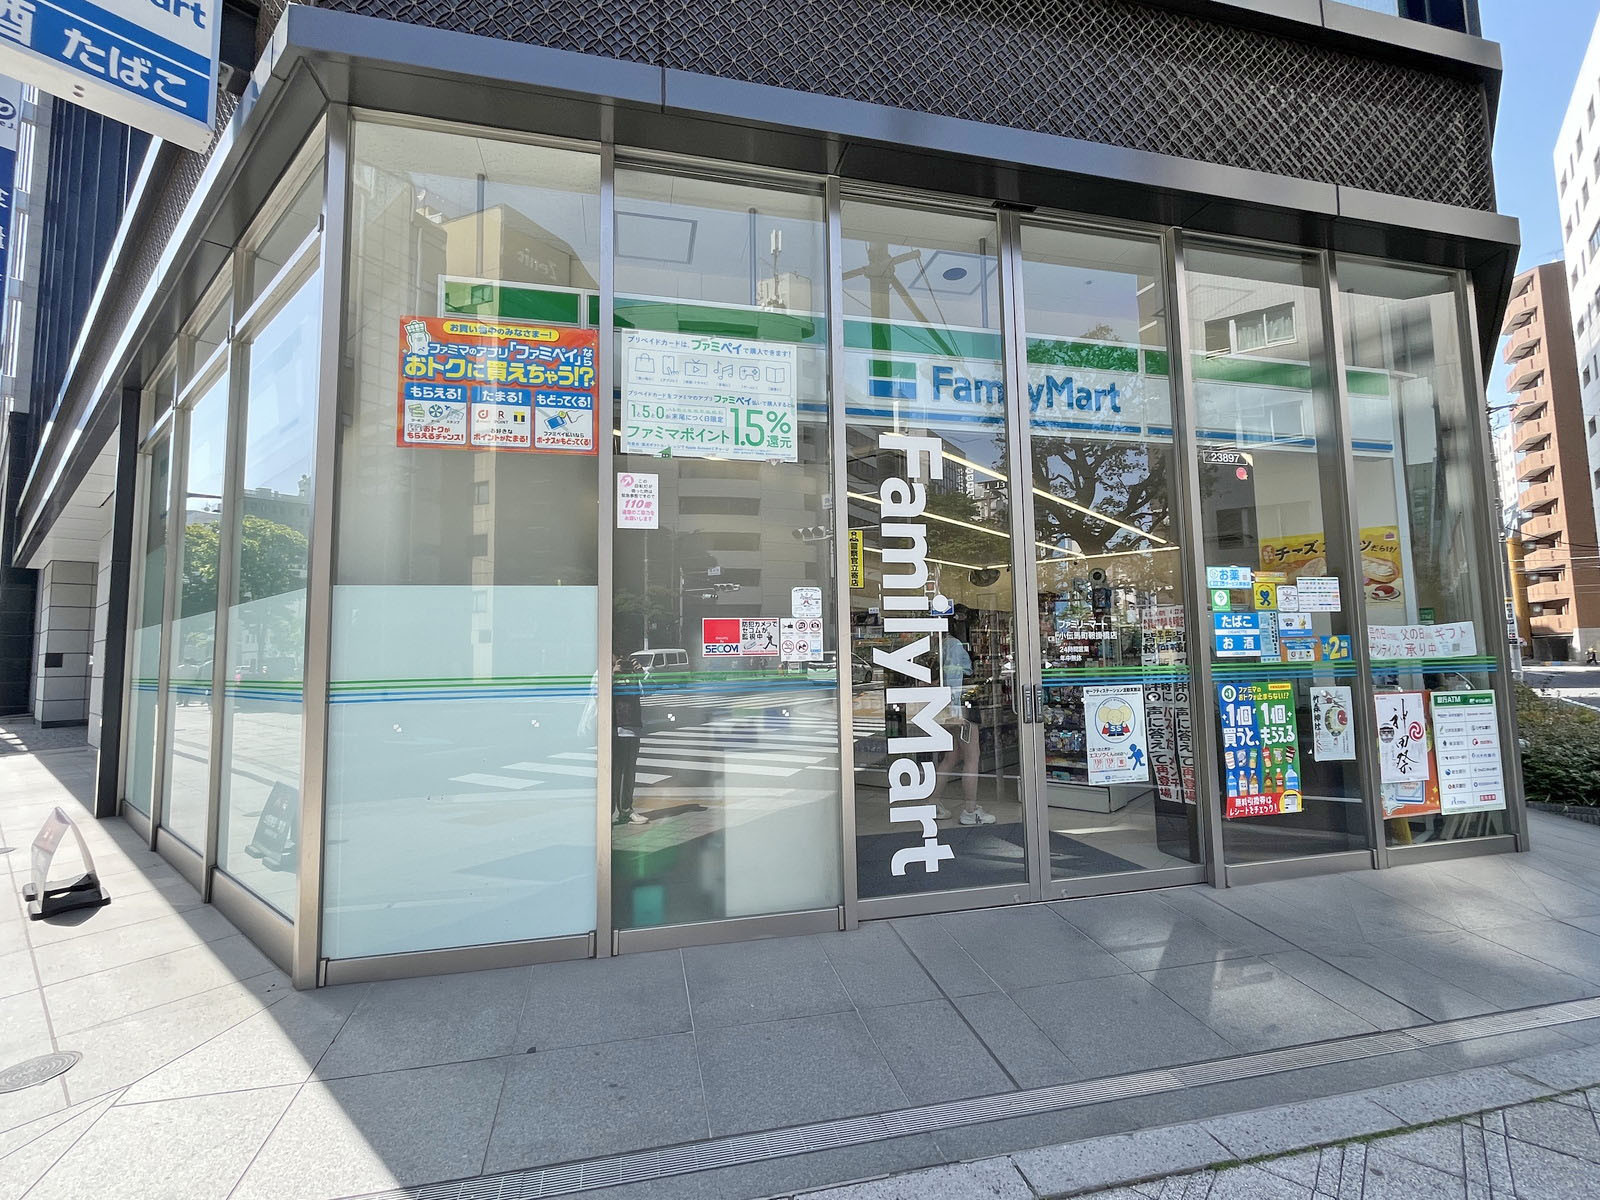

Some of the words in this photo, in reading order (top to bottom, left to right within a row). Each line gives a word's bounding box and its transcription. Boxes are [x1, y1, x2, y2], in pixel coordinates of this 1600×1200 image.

[62, 28, 188, 109] たばこ
[410, 386, 462, 400] もらえる!
[482, 388, 523, 404] たまる!
[932, 365, 1121, 413] FamyMart
[537, 394, 592, 408] もどってくる!
[628, 426, 730, 444] ファミマポイント
[767, 435, 792, 449] 還元
[1210, 452, 1241, 464] 23897
[1275, 540, 1319, 562] チーズ
[1058, 619, 1108, 630] ファミリーマート
[1221, 615, 1253, 628] たばこ
[1435, 626, 1466, 641] ギフト
[705, 644, 739, 653] SECOM
[873, 434, 955, 877] FamilyMart
[1260, 725, 1296, 746] もらえる
